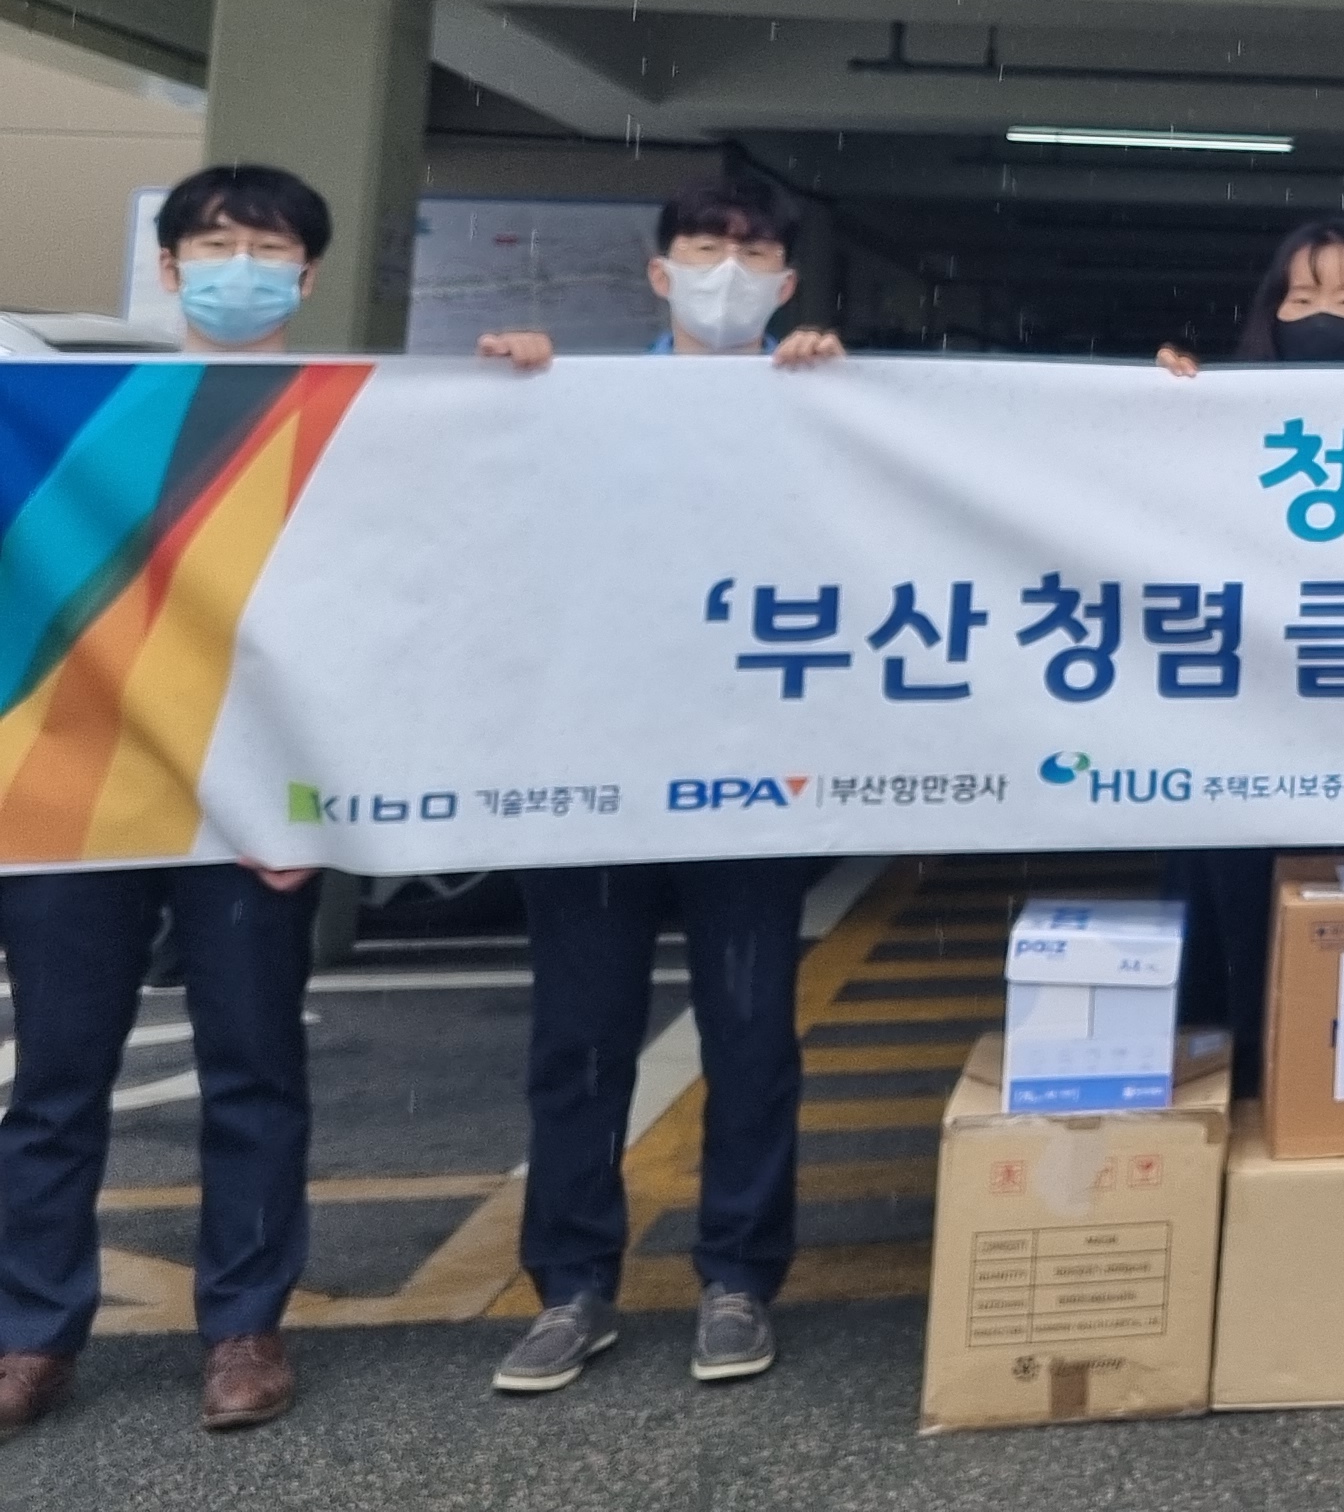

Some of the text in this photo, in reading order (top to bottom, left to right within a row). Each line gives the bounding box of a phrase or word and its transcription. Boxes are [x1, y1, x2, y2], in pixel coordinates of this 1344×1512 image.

[1015, 571, 1243, 702] 청렴
[476, 784, 621, 817] 기술보증기금
[666, 778, 789, 812] BPA
[830, 773, 1008, 806] 부산항만공사
[1091, 768, 1192, 803] HUG
